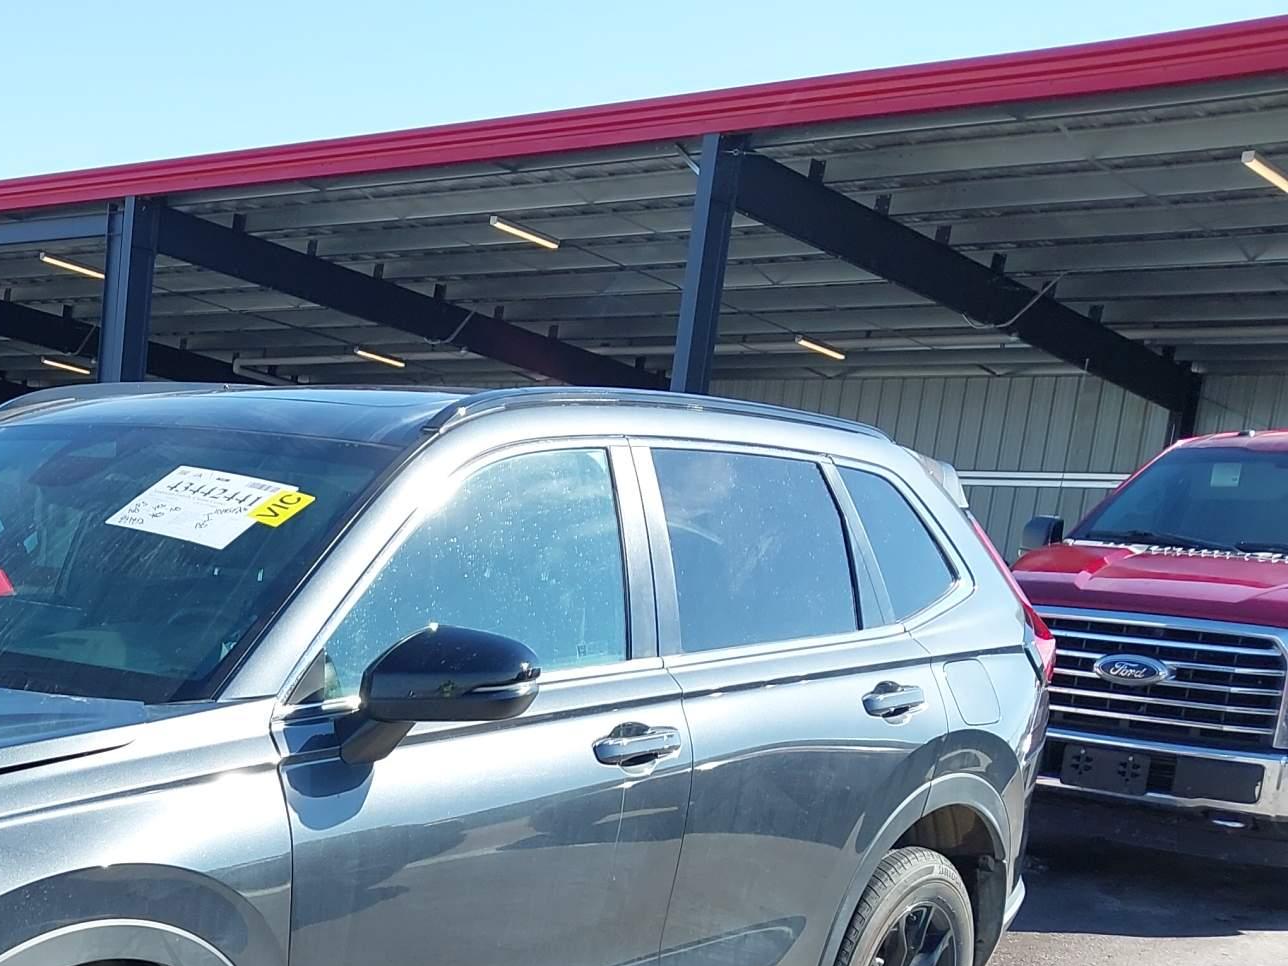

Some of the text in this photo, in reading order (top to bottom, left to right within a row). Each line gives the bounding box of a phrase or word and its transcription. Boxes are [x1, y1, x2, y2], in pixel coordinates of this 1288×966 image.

[167, 480, 262, 507] 43442441
[256, 494, 302, 519] VIC
[1109, 661, 1147, 678] Ford
